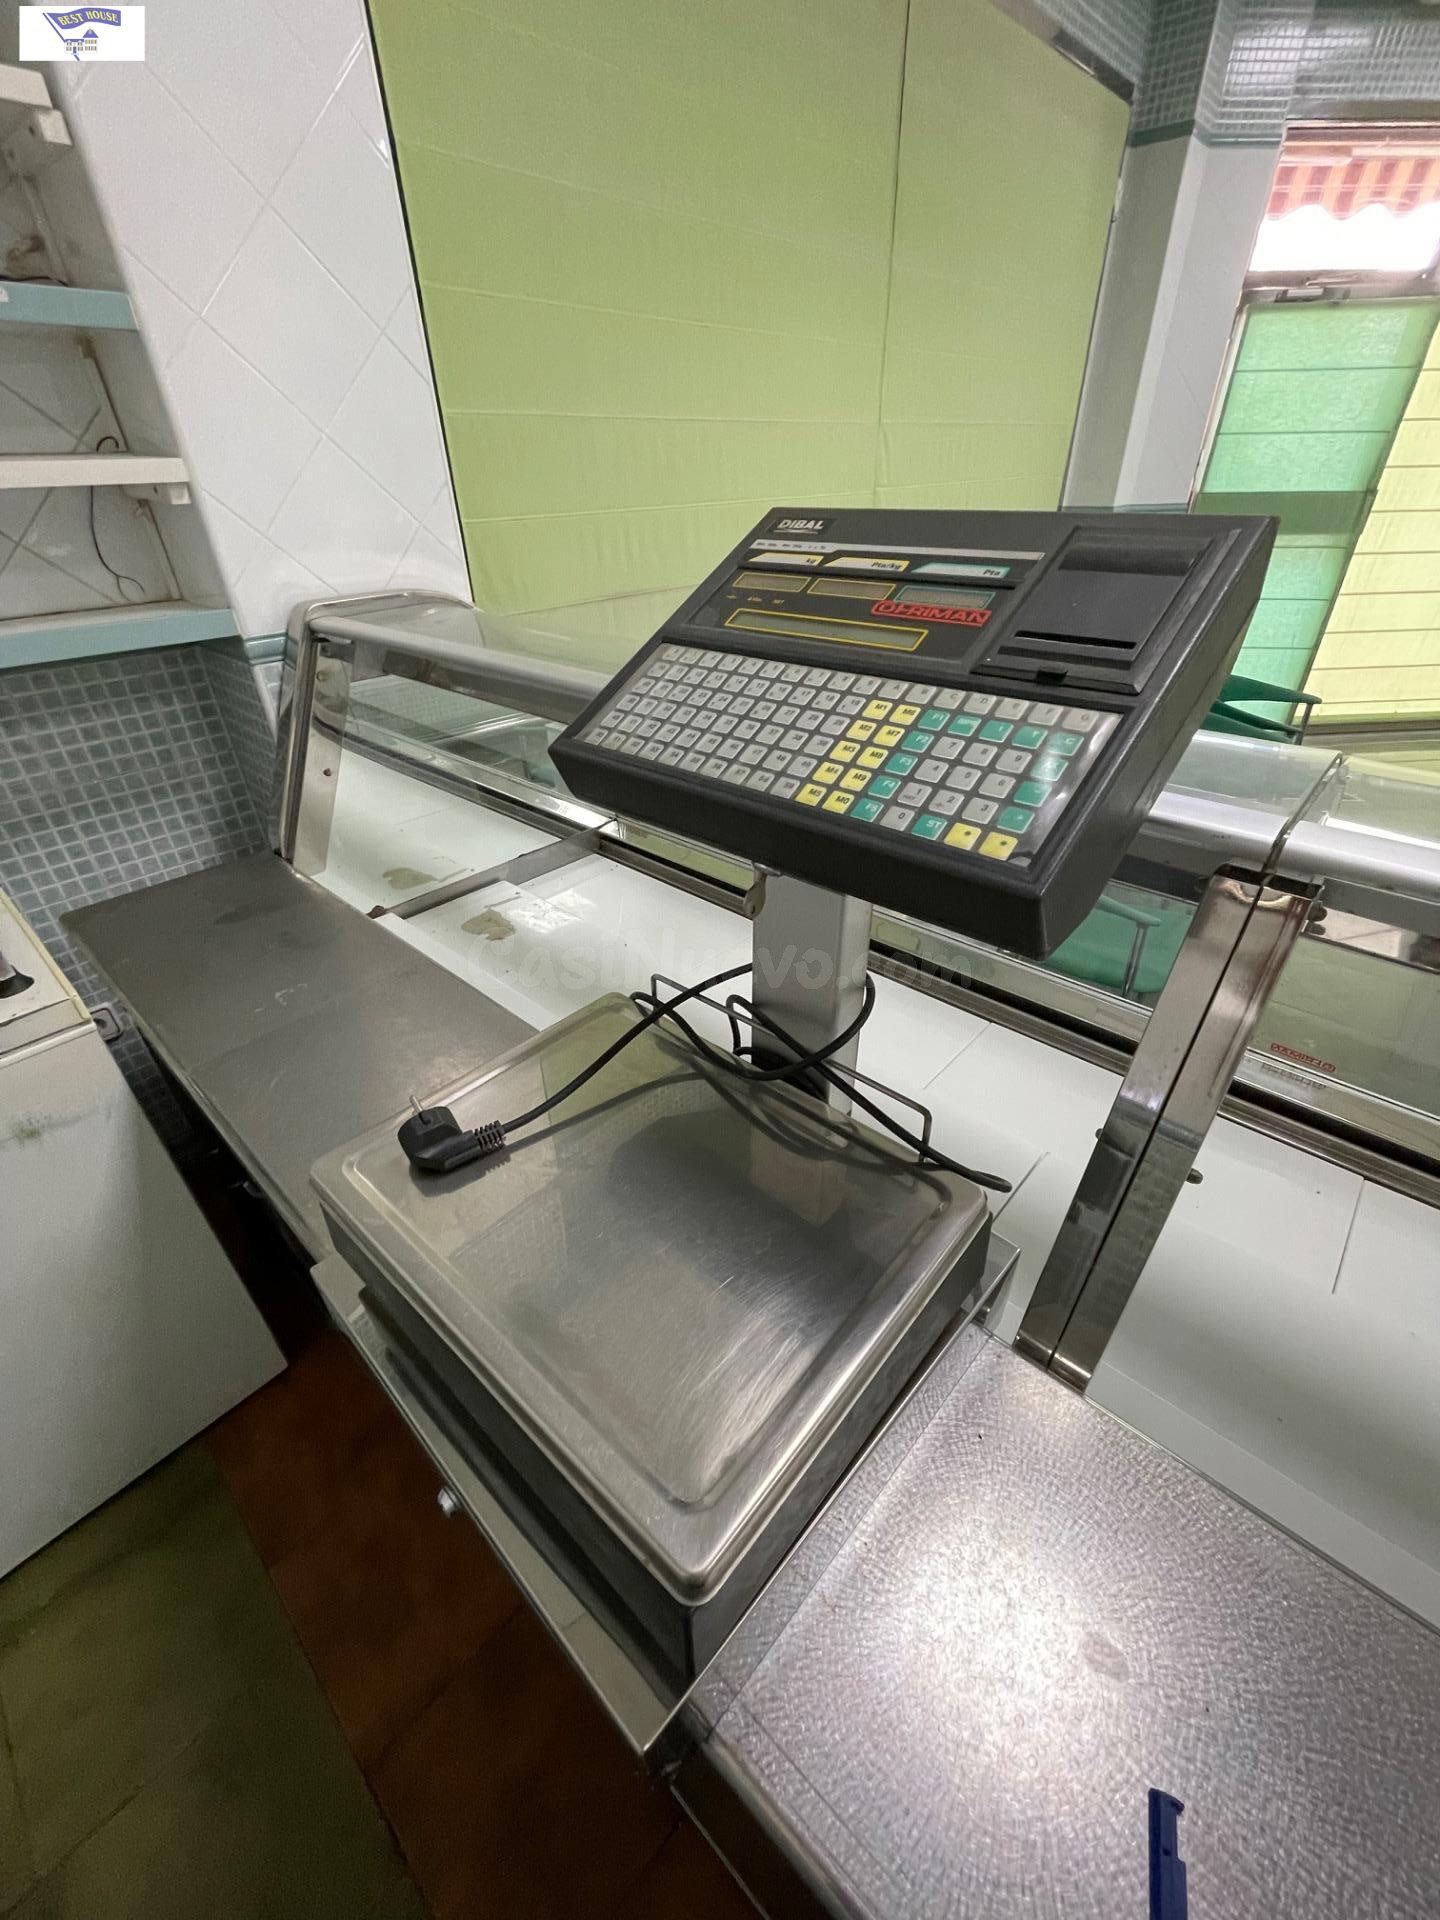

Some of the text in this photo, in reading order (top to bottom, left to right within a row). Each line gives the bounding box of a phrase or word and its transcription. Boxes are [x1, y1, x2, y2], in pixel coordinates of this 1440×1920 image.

[777, 519, 825, 530] DIBAL
[983, 568, 1001, 577] Pta
[874, 600, 991, 626] OFRIMAN
[886, 729, 900, 737] M7
[843, 744, 856, 752] M3
[825, 766, 839, 774] M4
[853, 773, 867, 781] M9
[883, 780, 895, 788] F4
[808, 788, 822, 797] M5
[836, 795, 850, 804] M0
[926, 820, 942, 828] ST
